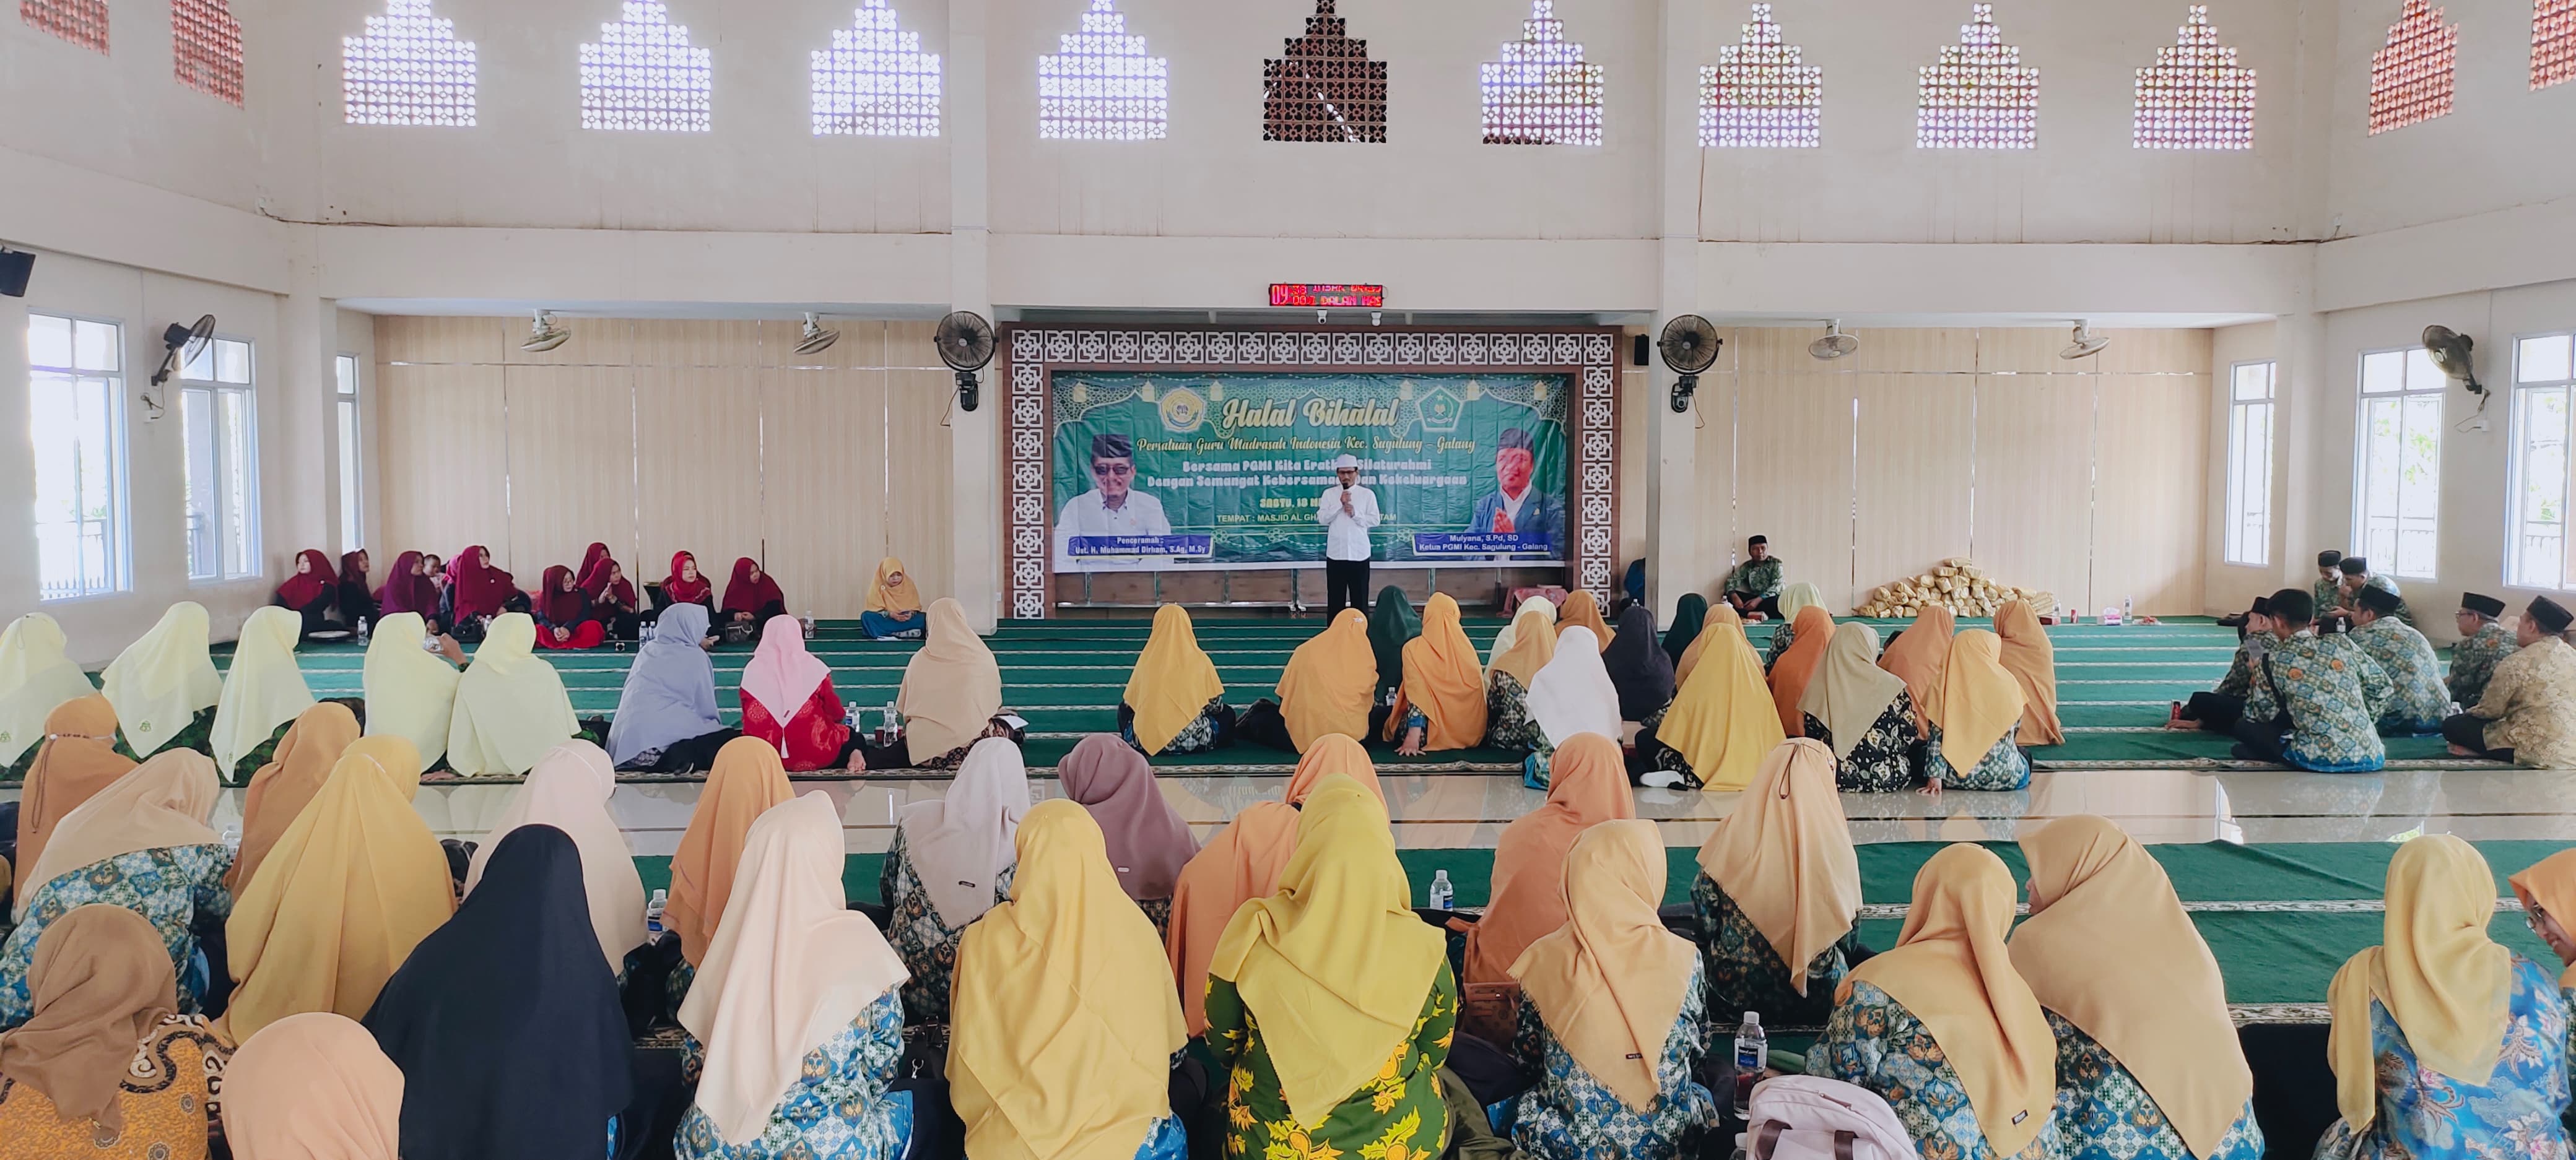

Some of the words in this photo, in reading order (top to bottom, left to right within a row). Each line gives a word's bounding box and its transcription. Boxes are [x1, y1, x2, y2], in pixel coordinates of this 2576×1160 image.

[1221, 398, 1298, 430] Halal
[1302, 397, 1401, 426] Bihalal
[1137, 438, 1193, 452] Persatuan
[1196, 438, 1224, 456] Guru
[1228, 437, 1286, 451] Madrasah
[1290, 436, 1341, 450] Indonesia
[1183, 461, 1239, 472] Bersama
[1242, 460, 1273, 472] PGMI
[1274, 459, 1301, 471] Kita
[1147, 476, 1194, 490] Dengan
[1196, 475, 1260, 489] Semangat
[1379, 474, 1467, 488] Kekeluargaan
[1216, 514, 1250, 523] TEMPAT
[1449, 534, 1484, 542] Mulyana,
[1100, 546, 1140, 554] Muhammad
[1521, 543, 1549, 551] Galang
